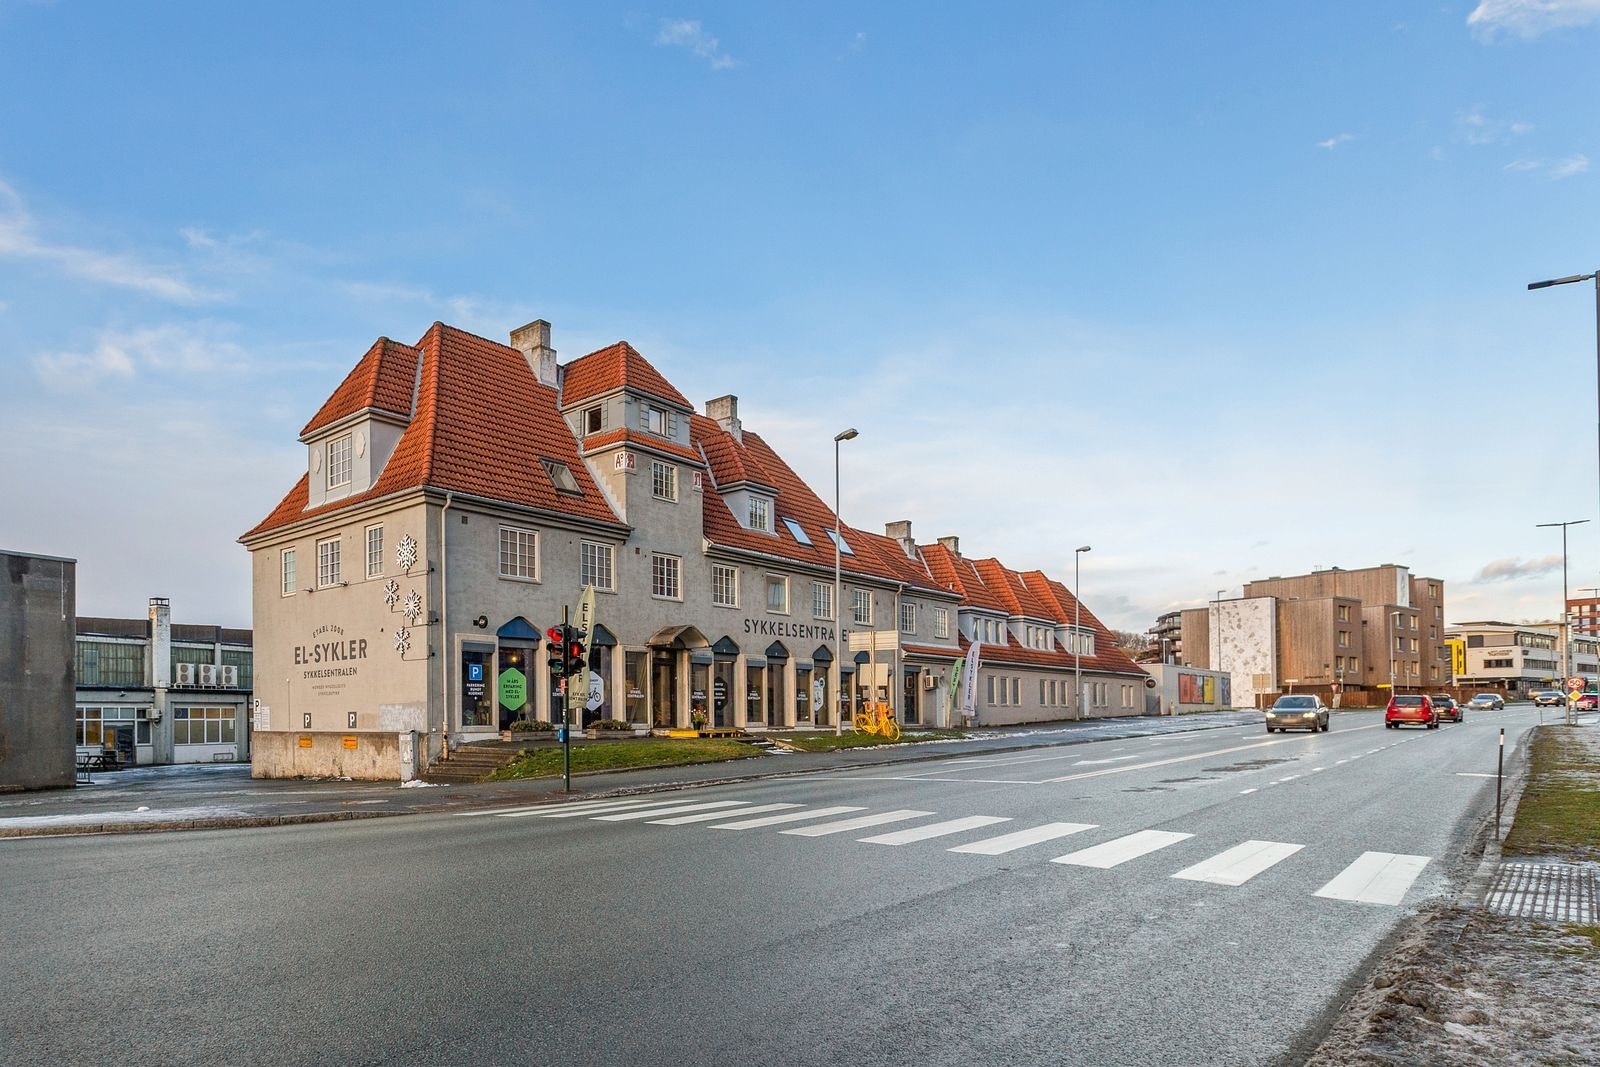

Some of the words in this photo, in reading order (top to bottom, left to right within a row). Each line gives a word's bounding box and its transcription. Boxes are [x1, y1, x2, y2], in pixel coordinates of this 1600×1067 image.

[312, 624, 329, 639] ETABL
[744, 618, 854, 642] SYKKELSENTRAE
[294, 638, 368, 665] EL-SYKLER
[303, 666, 358, 680] SYKKELSENTRALEN
[472, 666, 479, 678] P
[1569, 679, 1581, 687] 50
[305, 714, 310, 727] P
[349, 713, 355, 726] P
